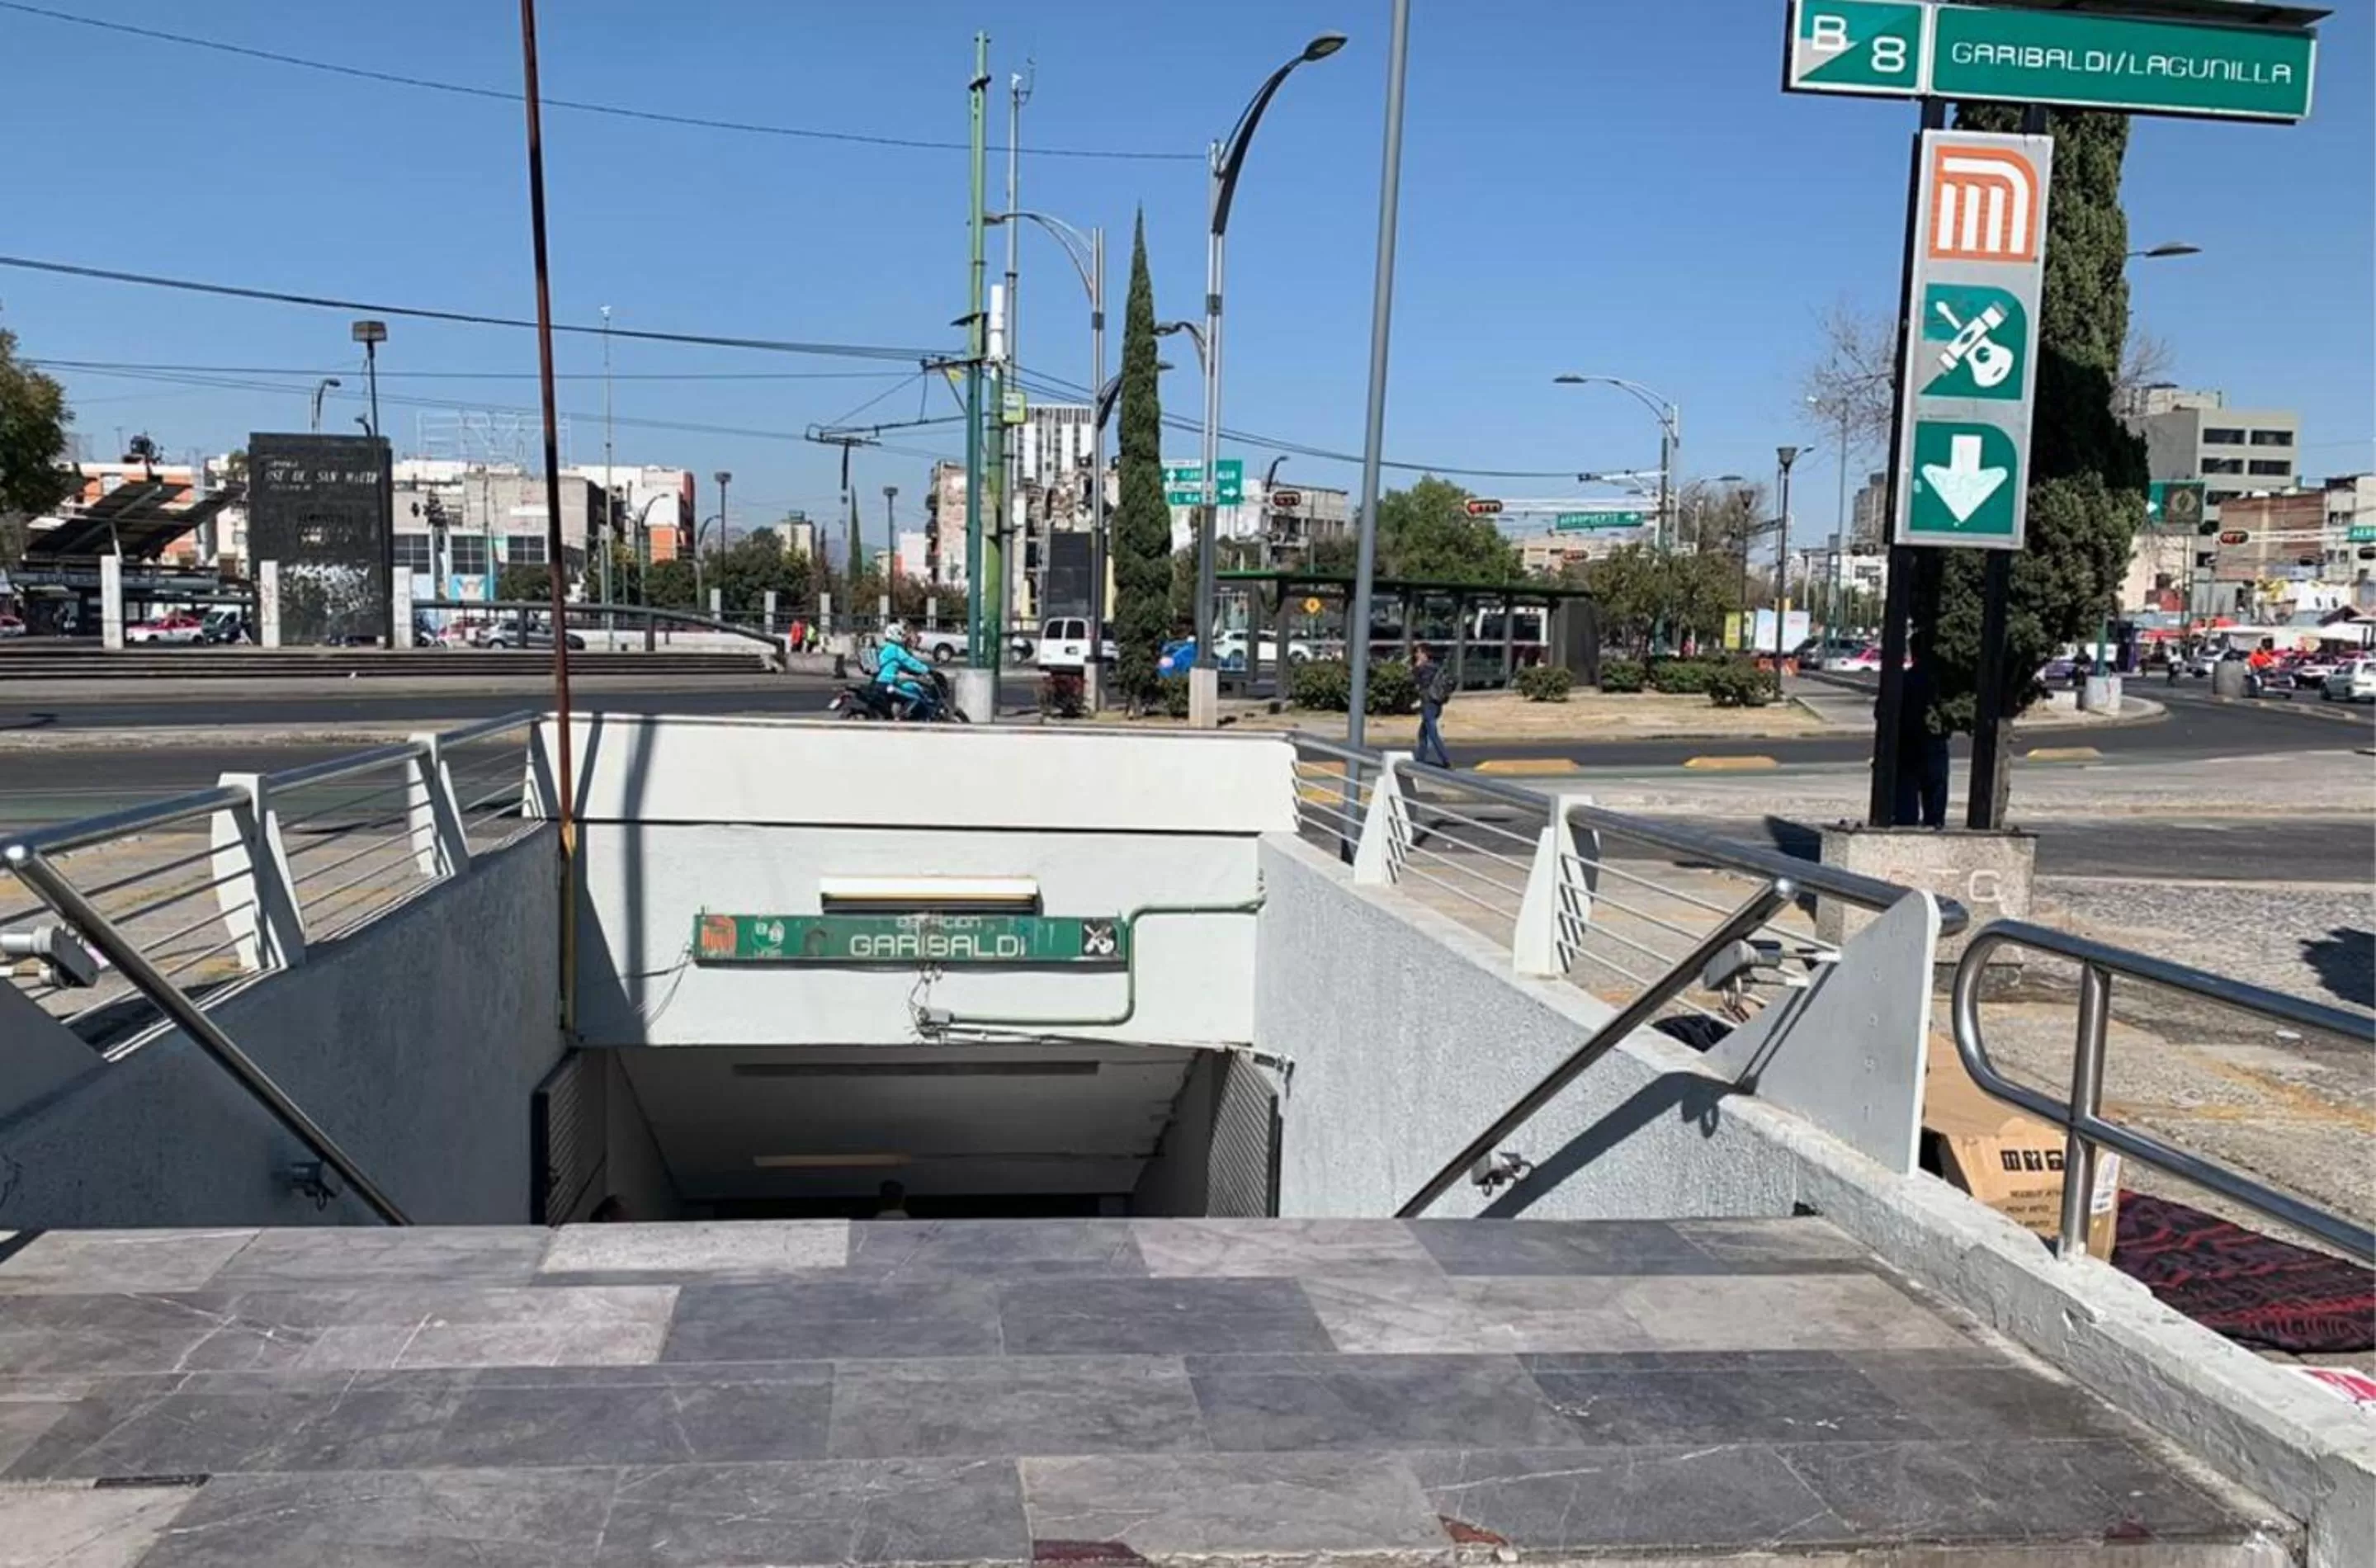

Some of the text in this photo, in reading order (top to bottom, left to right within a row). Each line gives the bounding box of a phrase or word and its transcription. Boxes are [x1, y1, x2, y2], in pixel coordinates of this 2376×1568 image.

[1813, 15, 1906, 73] B 8
[1952, 42, 2291, 83] GARIBALDI/LAGUNILLA
[849, 934, 1026, 957] GARIBALDI
